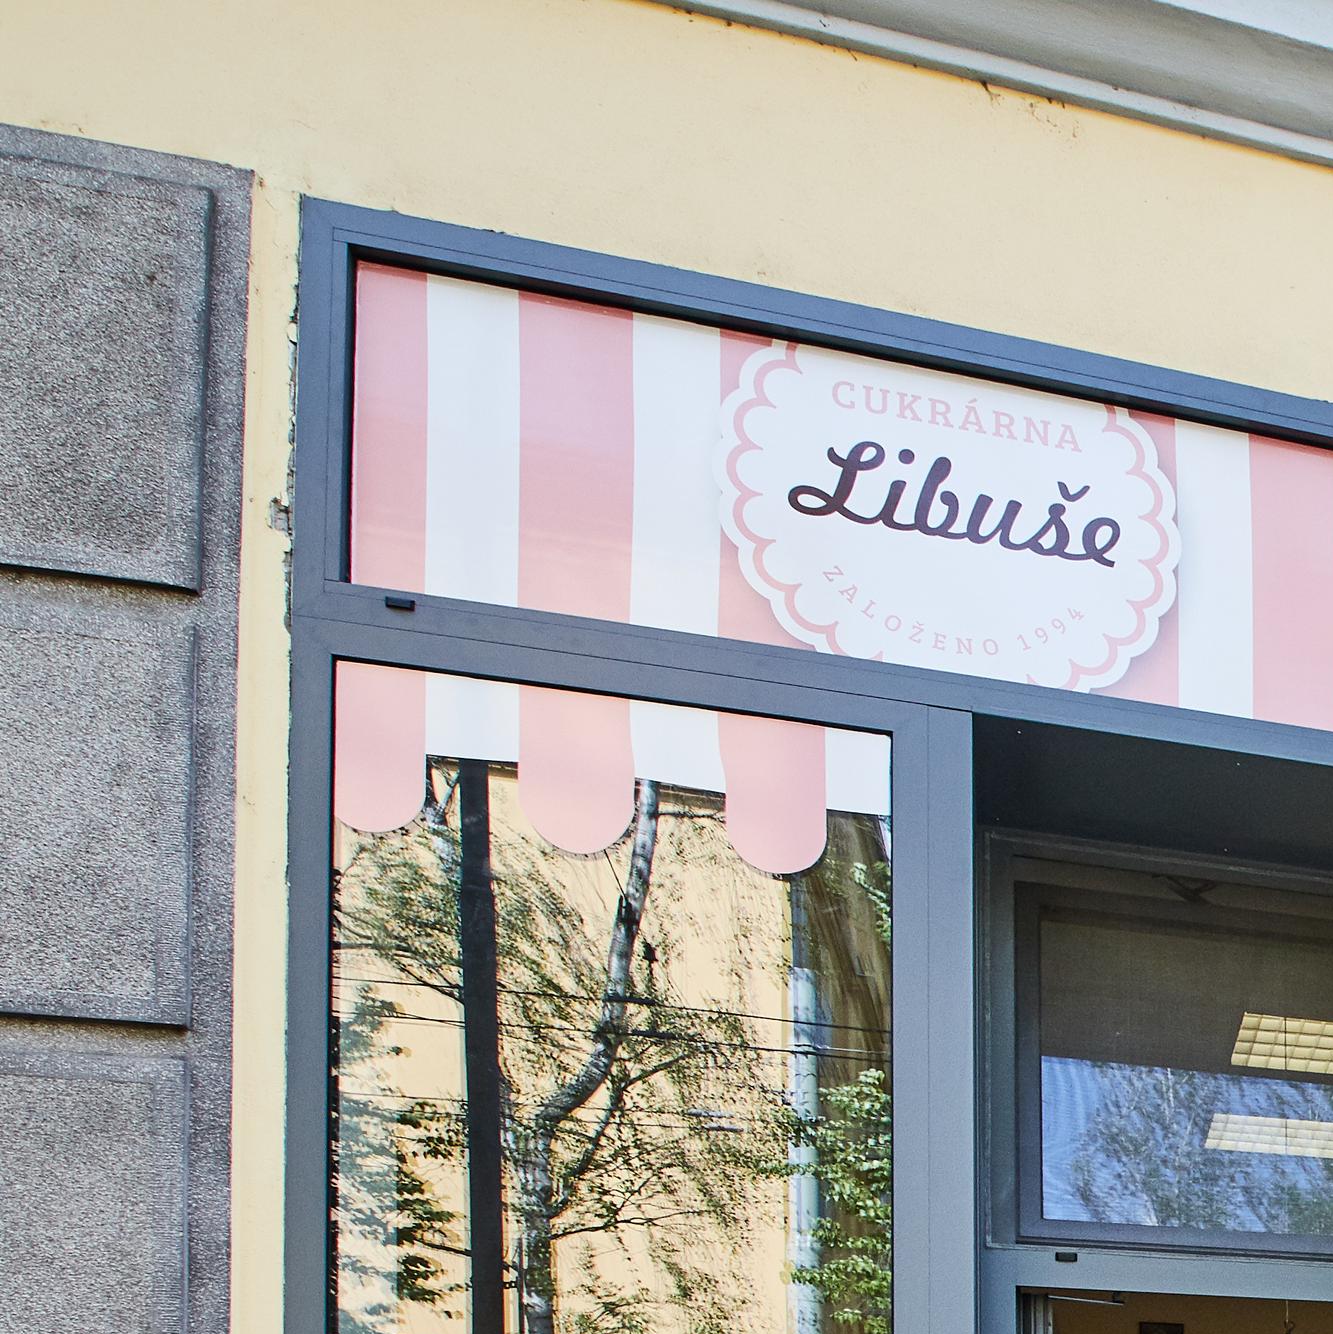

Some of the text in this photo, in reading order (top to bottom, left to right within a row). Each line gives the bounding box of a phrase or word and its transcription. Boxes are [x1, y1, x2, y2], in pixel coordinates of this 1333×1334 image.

[832, 380, 1082, 454] CUKRÁRNA
[787, 441, 1121, 568] Libuše
[822, 565, 1086, 656] ZALOŽENO 1994
